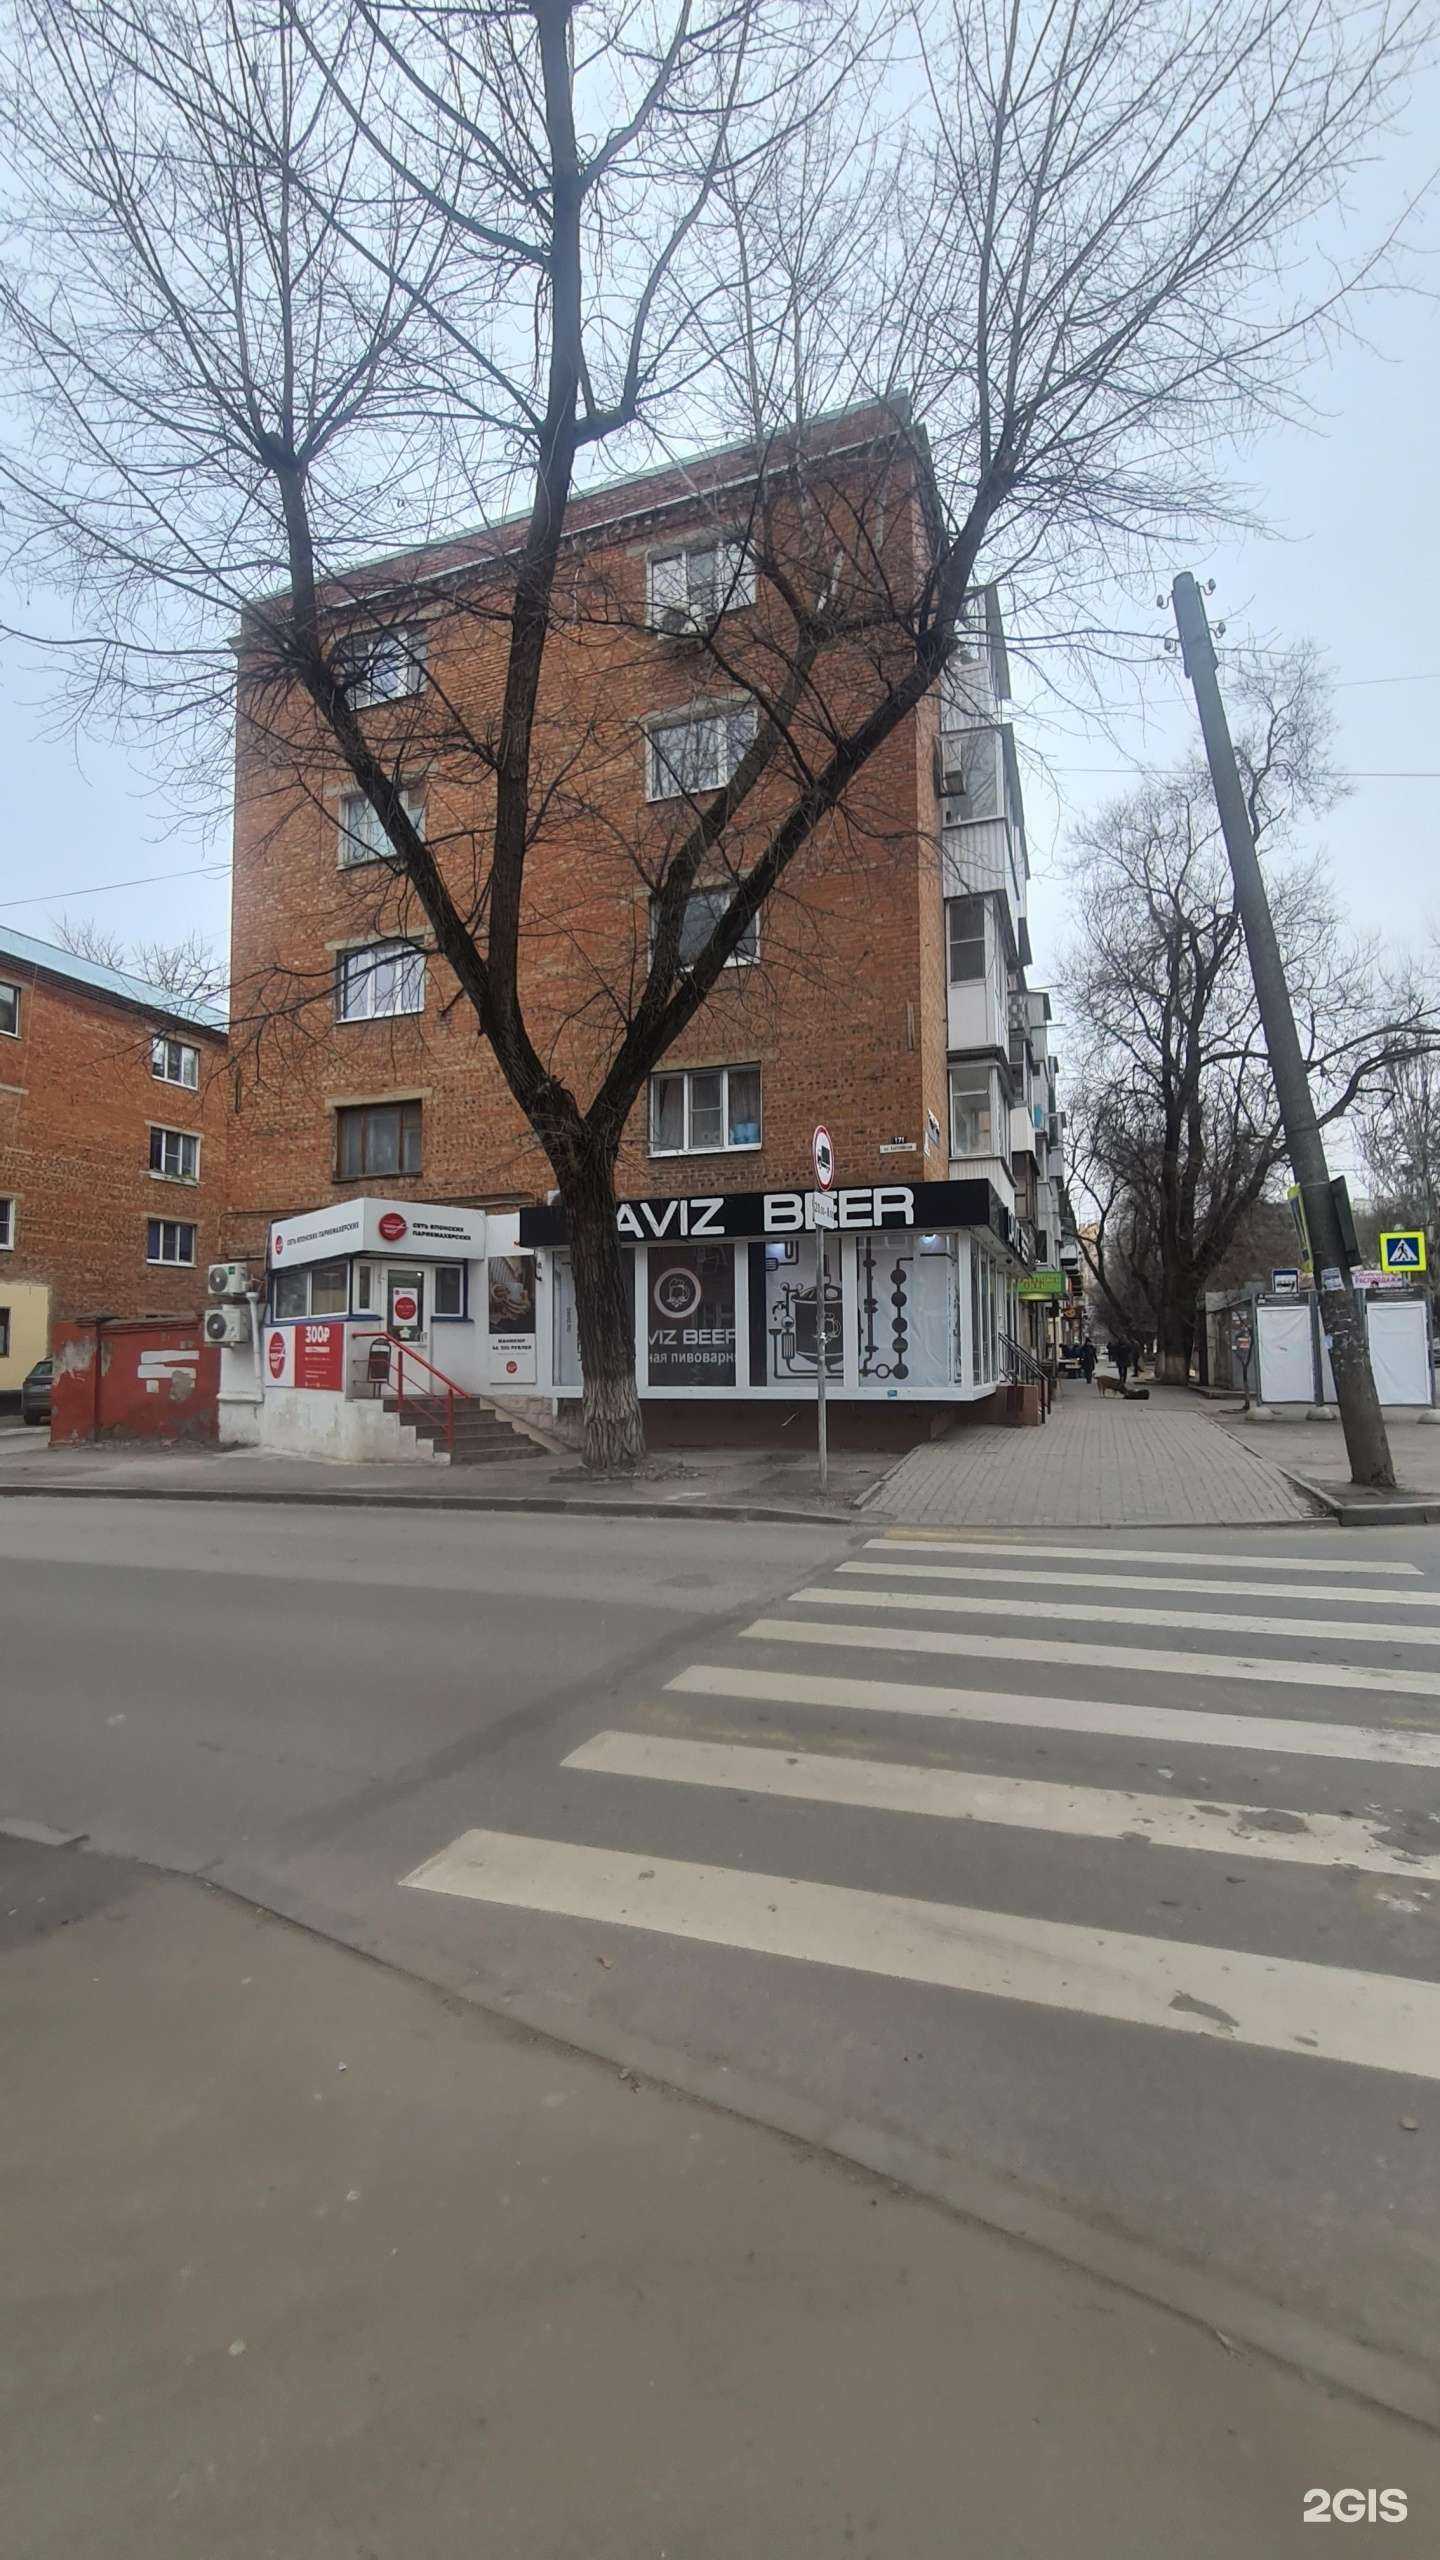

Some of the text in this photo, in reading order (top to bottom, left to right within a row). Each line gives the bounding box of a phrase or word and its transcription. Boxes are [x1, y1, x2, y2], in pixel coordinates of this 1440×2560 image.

[763, 1186, 914, 1232] BEER
[412, 1222, 428, 1230] СЕТЬ
[430, 1224, 464, 1233] ЯПОНСКИХ
[412, 1230, 472, 1241] ПАРИКМАХЕРСКИХ
[671, 1352, 736, 1366] пивоварн
